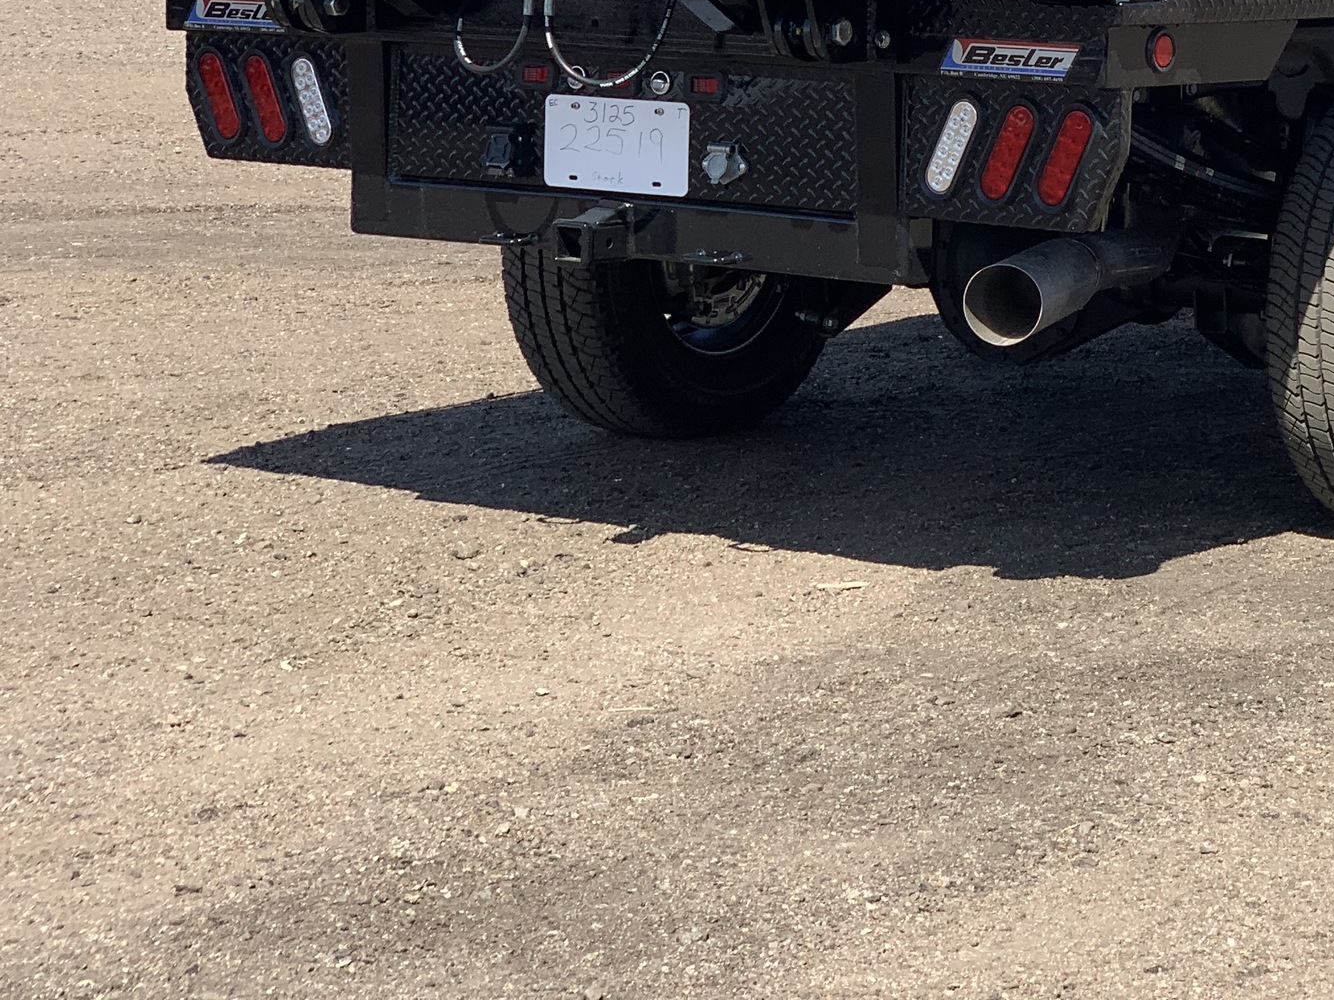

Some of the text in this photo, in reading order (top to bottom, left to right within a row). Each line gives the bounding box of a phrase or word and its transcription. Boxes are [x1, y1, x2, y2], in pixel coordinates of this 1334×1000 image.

[203, 1, 272, 20] Besl
[961, 45, 1065, 69] Besler
[583, 101, 636, 127] 3125
